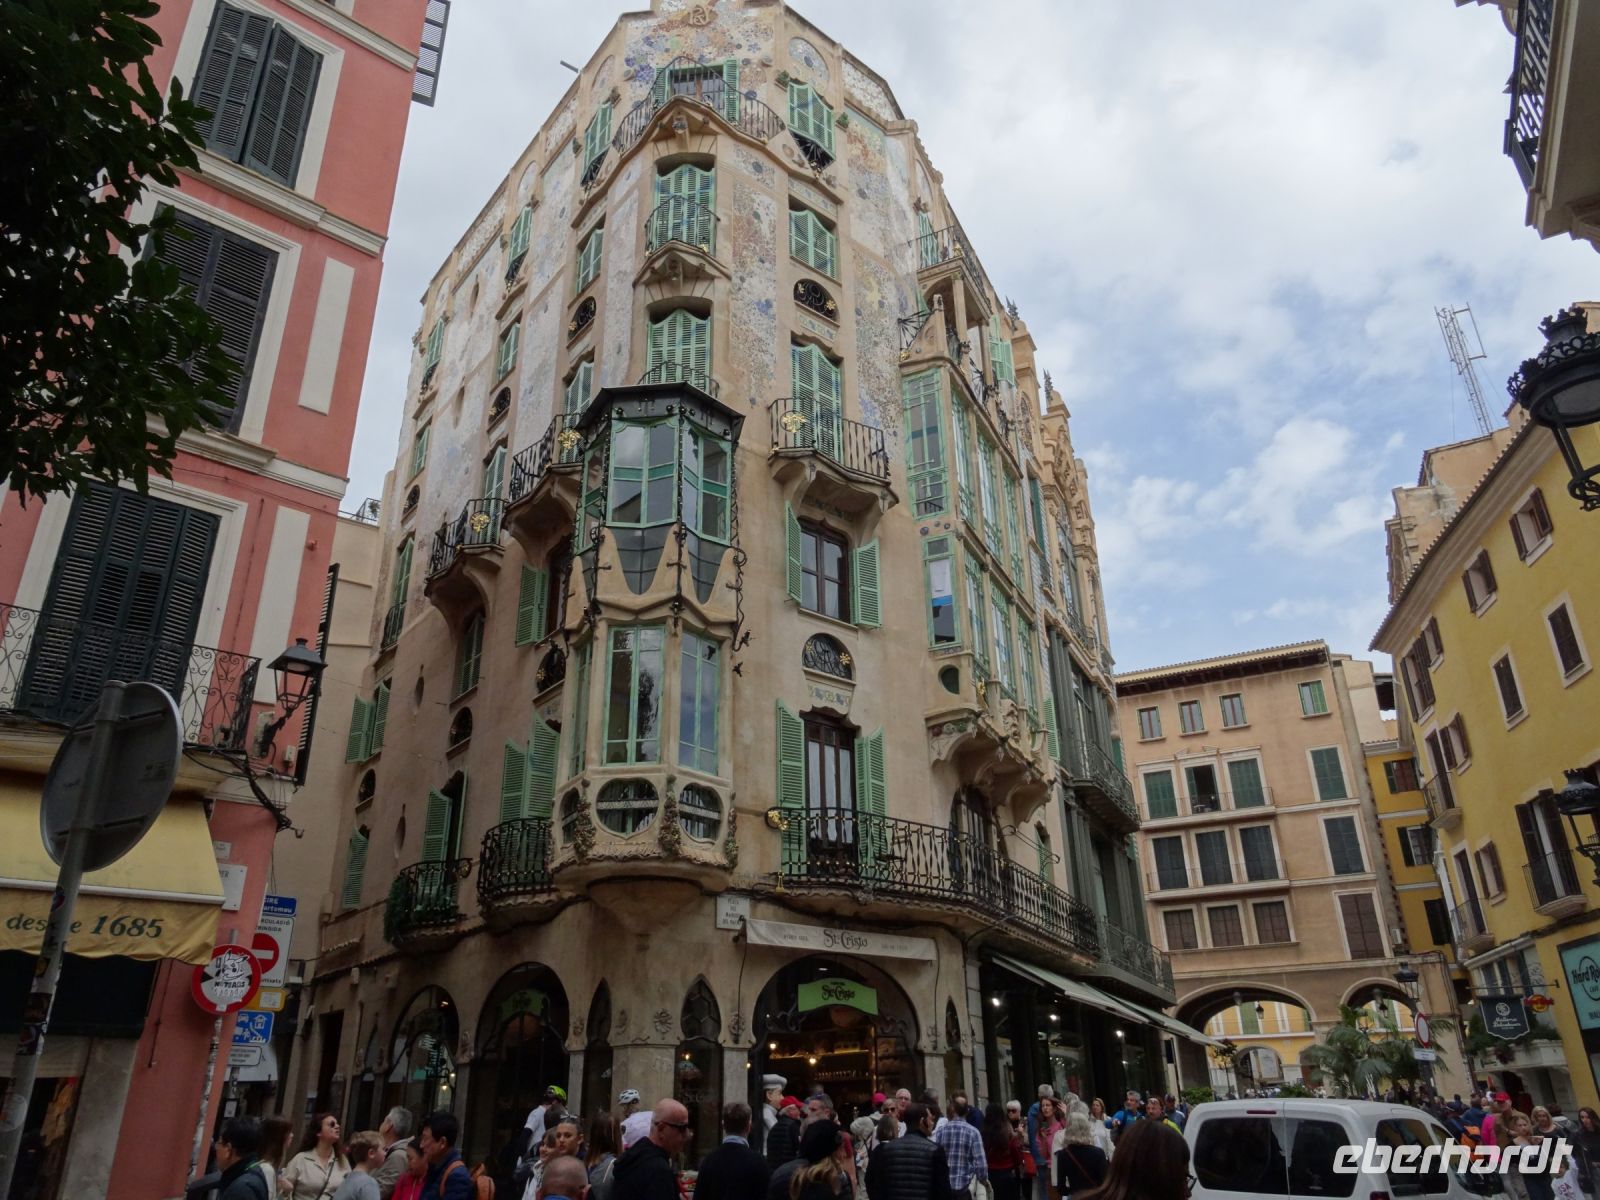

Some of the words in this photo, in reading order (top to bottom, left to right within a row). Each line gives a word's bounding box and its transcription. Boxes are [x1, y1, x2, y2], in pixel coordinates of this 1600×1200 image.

[6, 913, 82, 933] dese
[90, 915, 164, 938] 1685
[840, 932, 868, 950] Cristo
[1571, 966, 1590, 984] Hard
[1589, 964, 1600, 982] Ro
